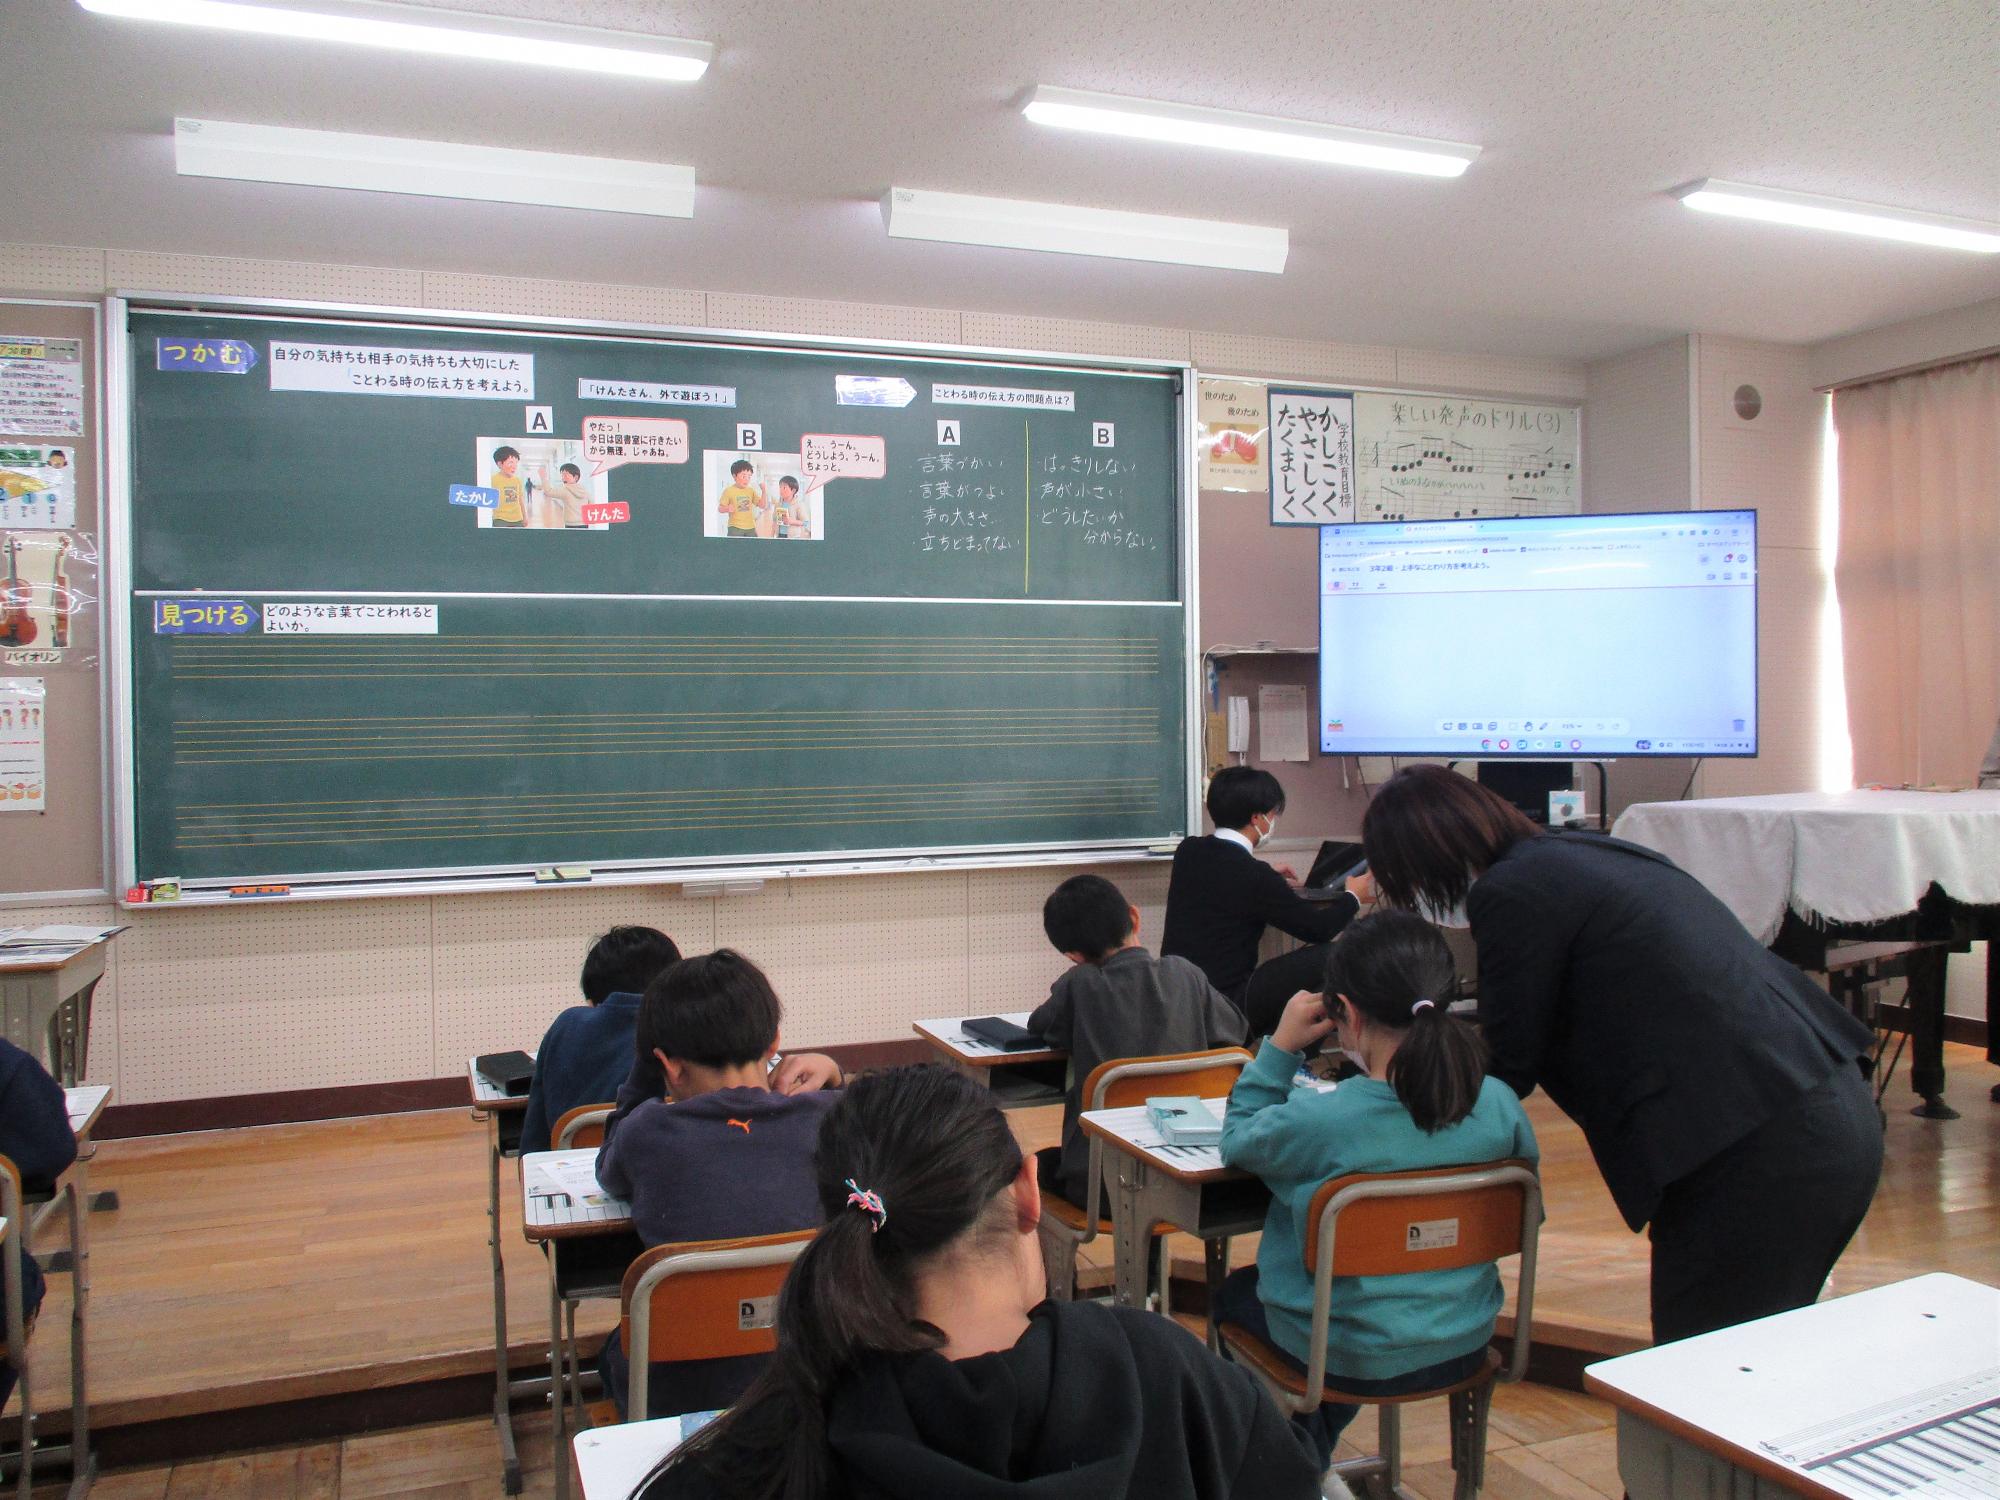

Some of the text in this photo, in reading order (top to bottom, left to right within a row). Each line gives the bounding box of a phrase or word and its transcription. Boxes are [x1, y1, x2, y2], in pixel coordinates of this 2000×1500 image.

[164, 343, 242, 365] つかむ
[275, 348, 520, 371] 自分の気持ちも相手の気持ちも大切にした
[352, 374, 529, 393] ことわる時の伝え方を考えよう。
[935, 388, 1070, 405] ことわる時の伝え方の問題点は？
[531, 411, 549, 431] A
[589, 434, 682, 446] 今日は図書室に行きたい
[742, 429, 757, 447] B
[942, 425, 956, 443] A
[1097, 429, 1110, 444] B
[589, 446, 670, 458] から無理。じゃあね。
[1278, 403, 1297, 518] たくましく
[1318, 405, 1338, 517] かしこく
[807, 462, 841, 473] ちょっと。
[1298, 406, 1318, 517] やさしく
[1337, 422, 1352, 508] 学校教育目標
[455, 490, 494, 505] たかし
[587, 507, 625, 522] けんた
[159, 604, 249, 627] 見つける
[266, 604, 433, 619] どのような言葉でことわれると
[266, 619, 310, 633] よいか。
[6, 651, 61, 663] バイオリン
